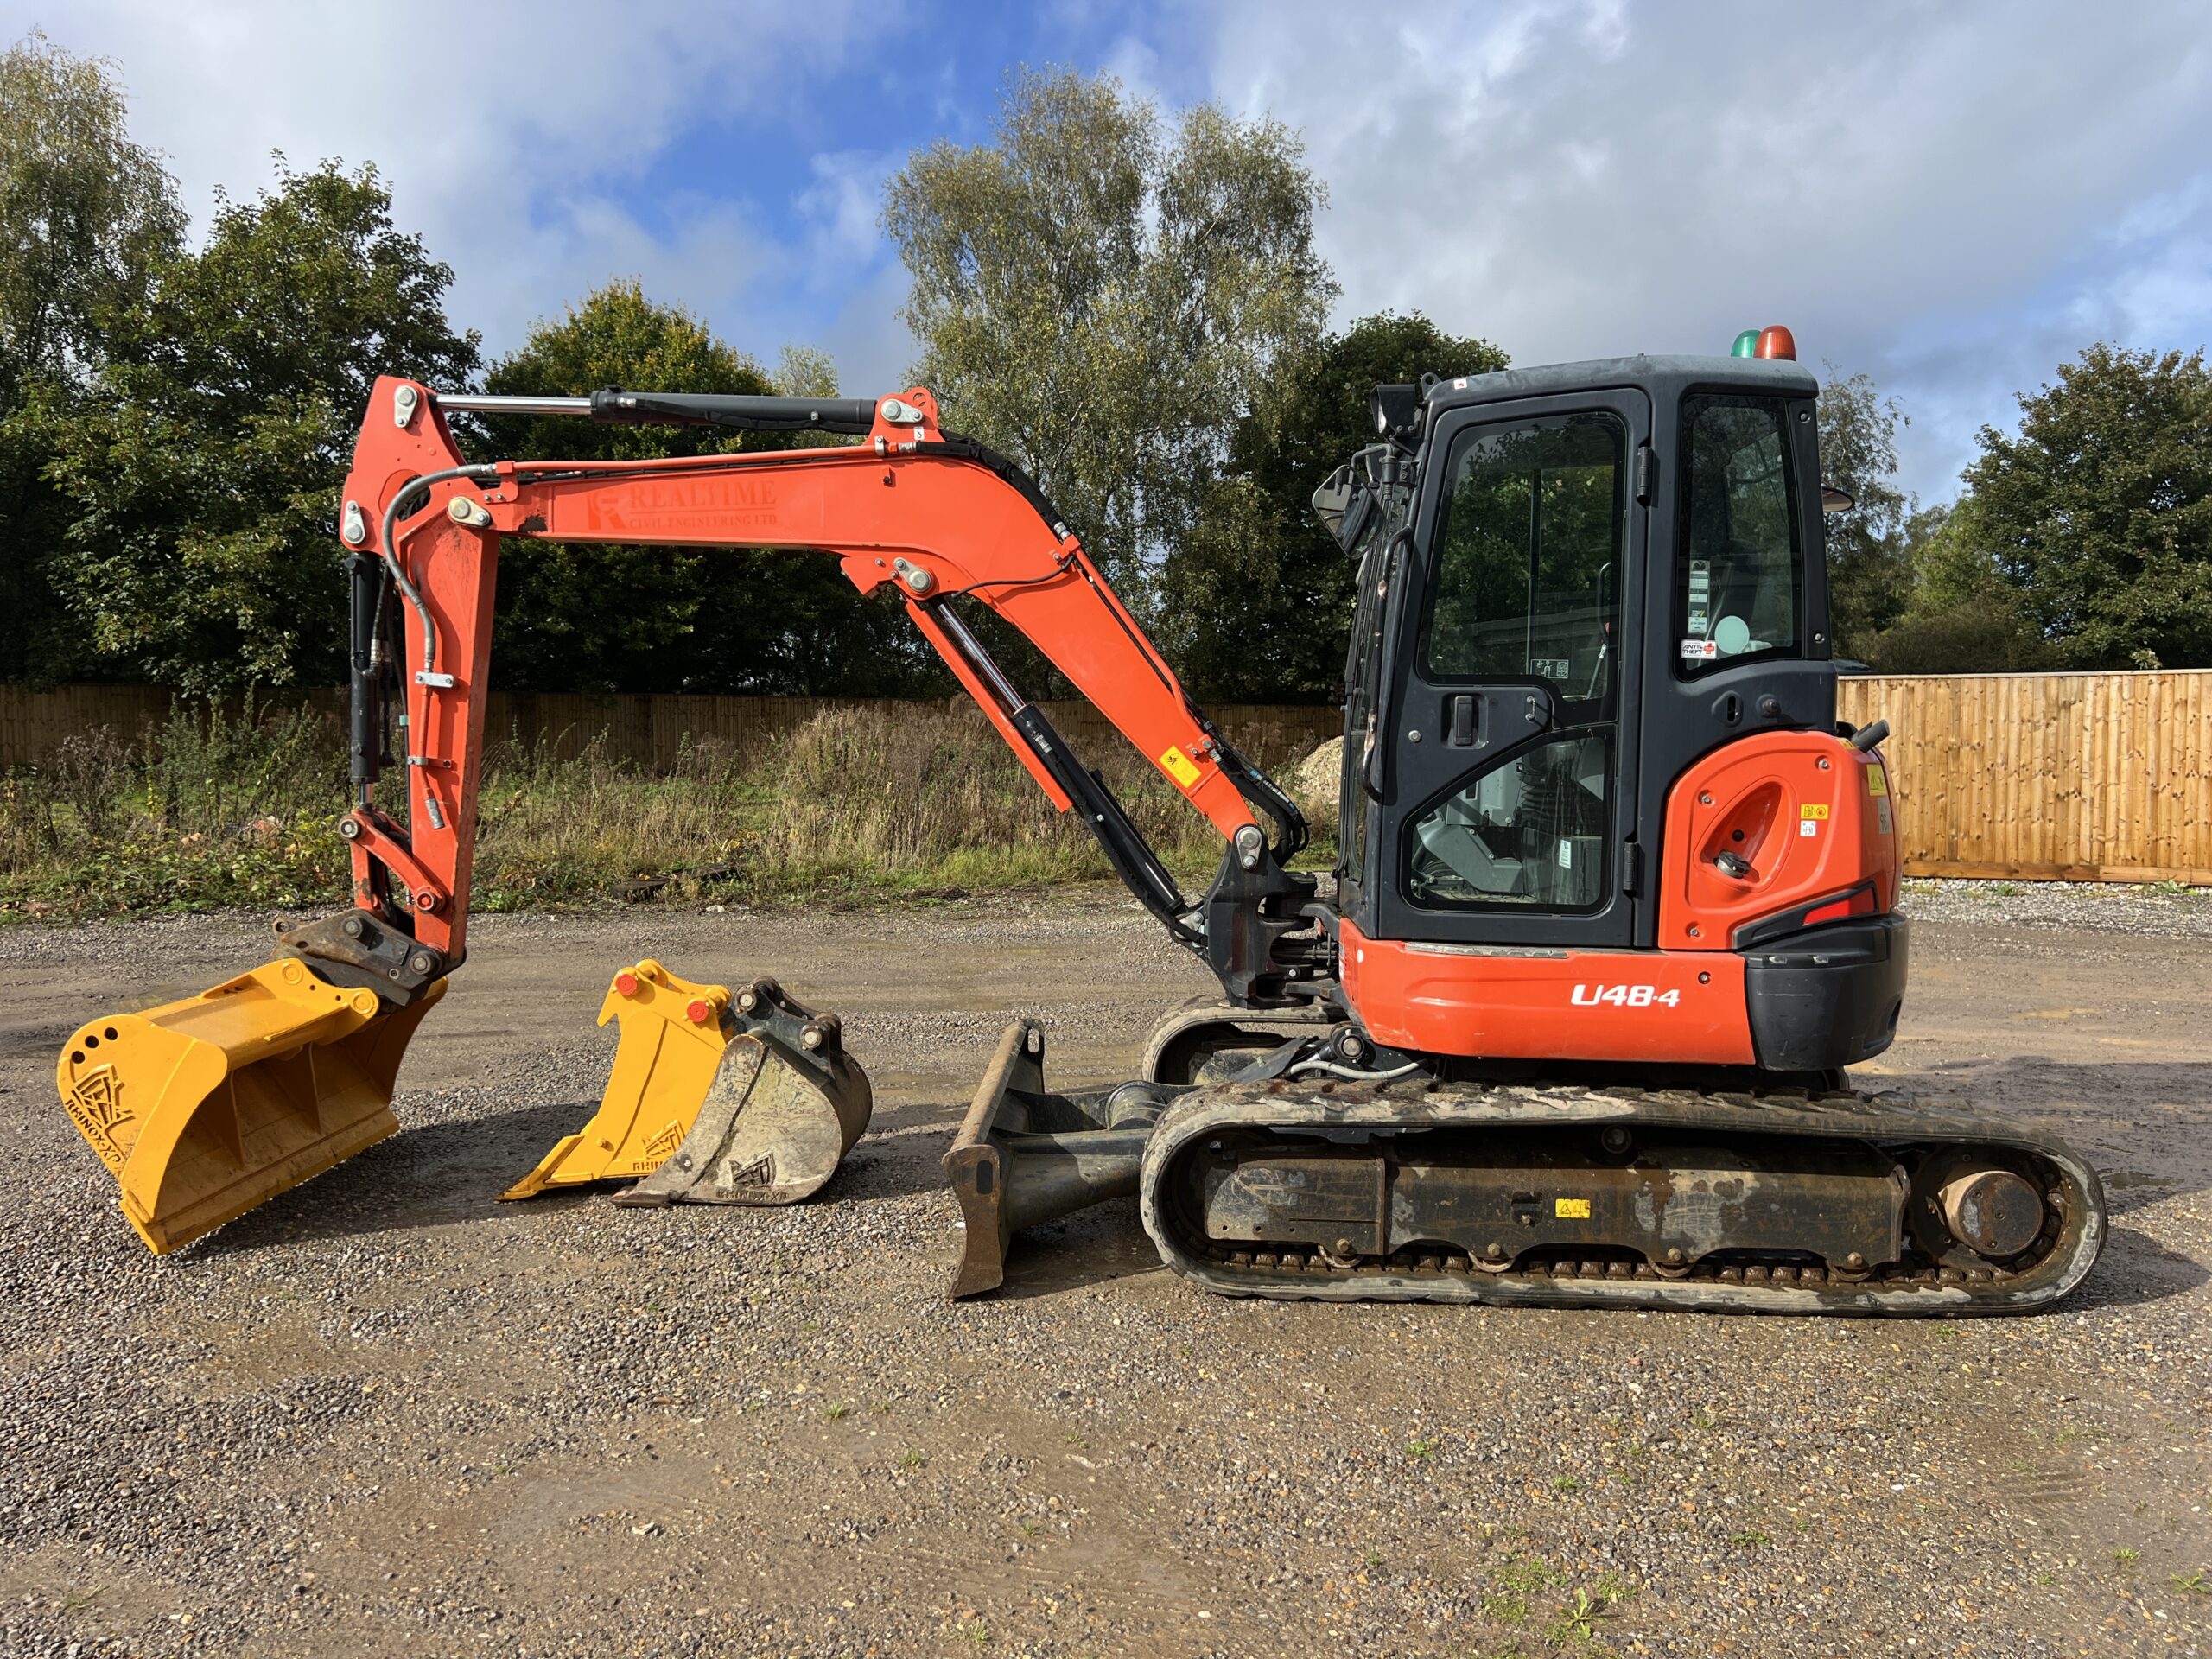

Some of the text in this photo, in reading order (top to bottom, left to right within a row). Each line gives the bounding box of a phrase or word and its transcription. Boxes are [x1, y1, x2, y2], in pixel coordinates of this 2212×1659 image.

[629, 480, 776, 508] REALTIME
[629, 514, 777, 530] CIVIL ENGINEERING LTD
[1571, 984, 1680, 1007] U48-4
[65, 1099, 121, 1162] RHINOX-XP
